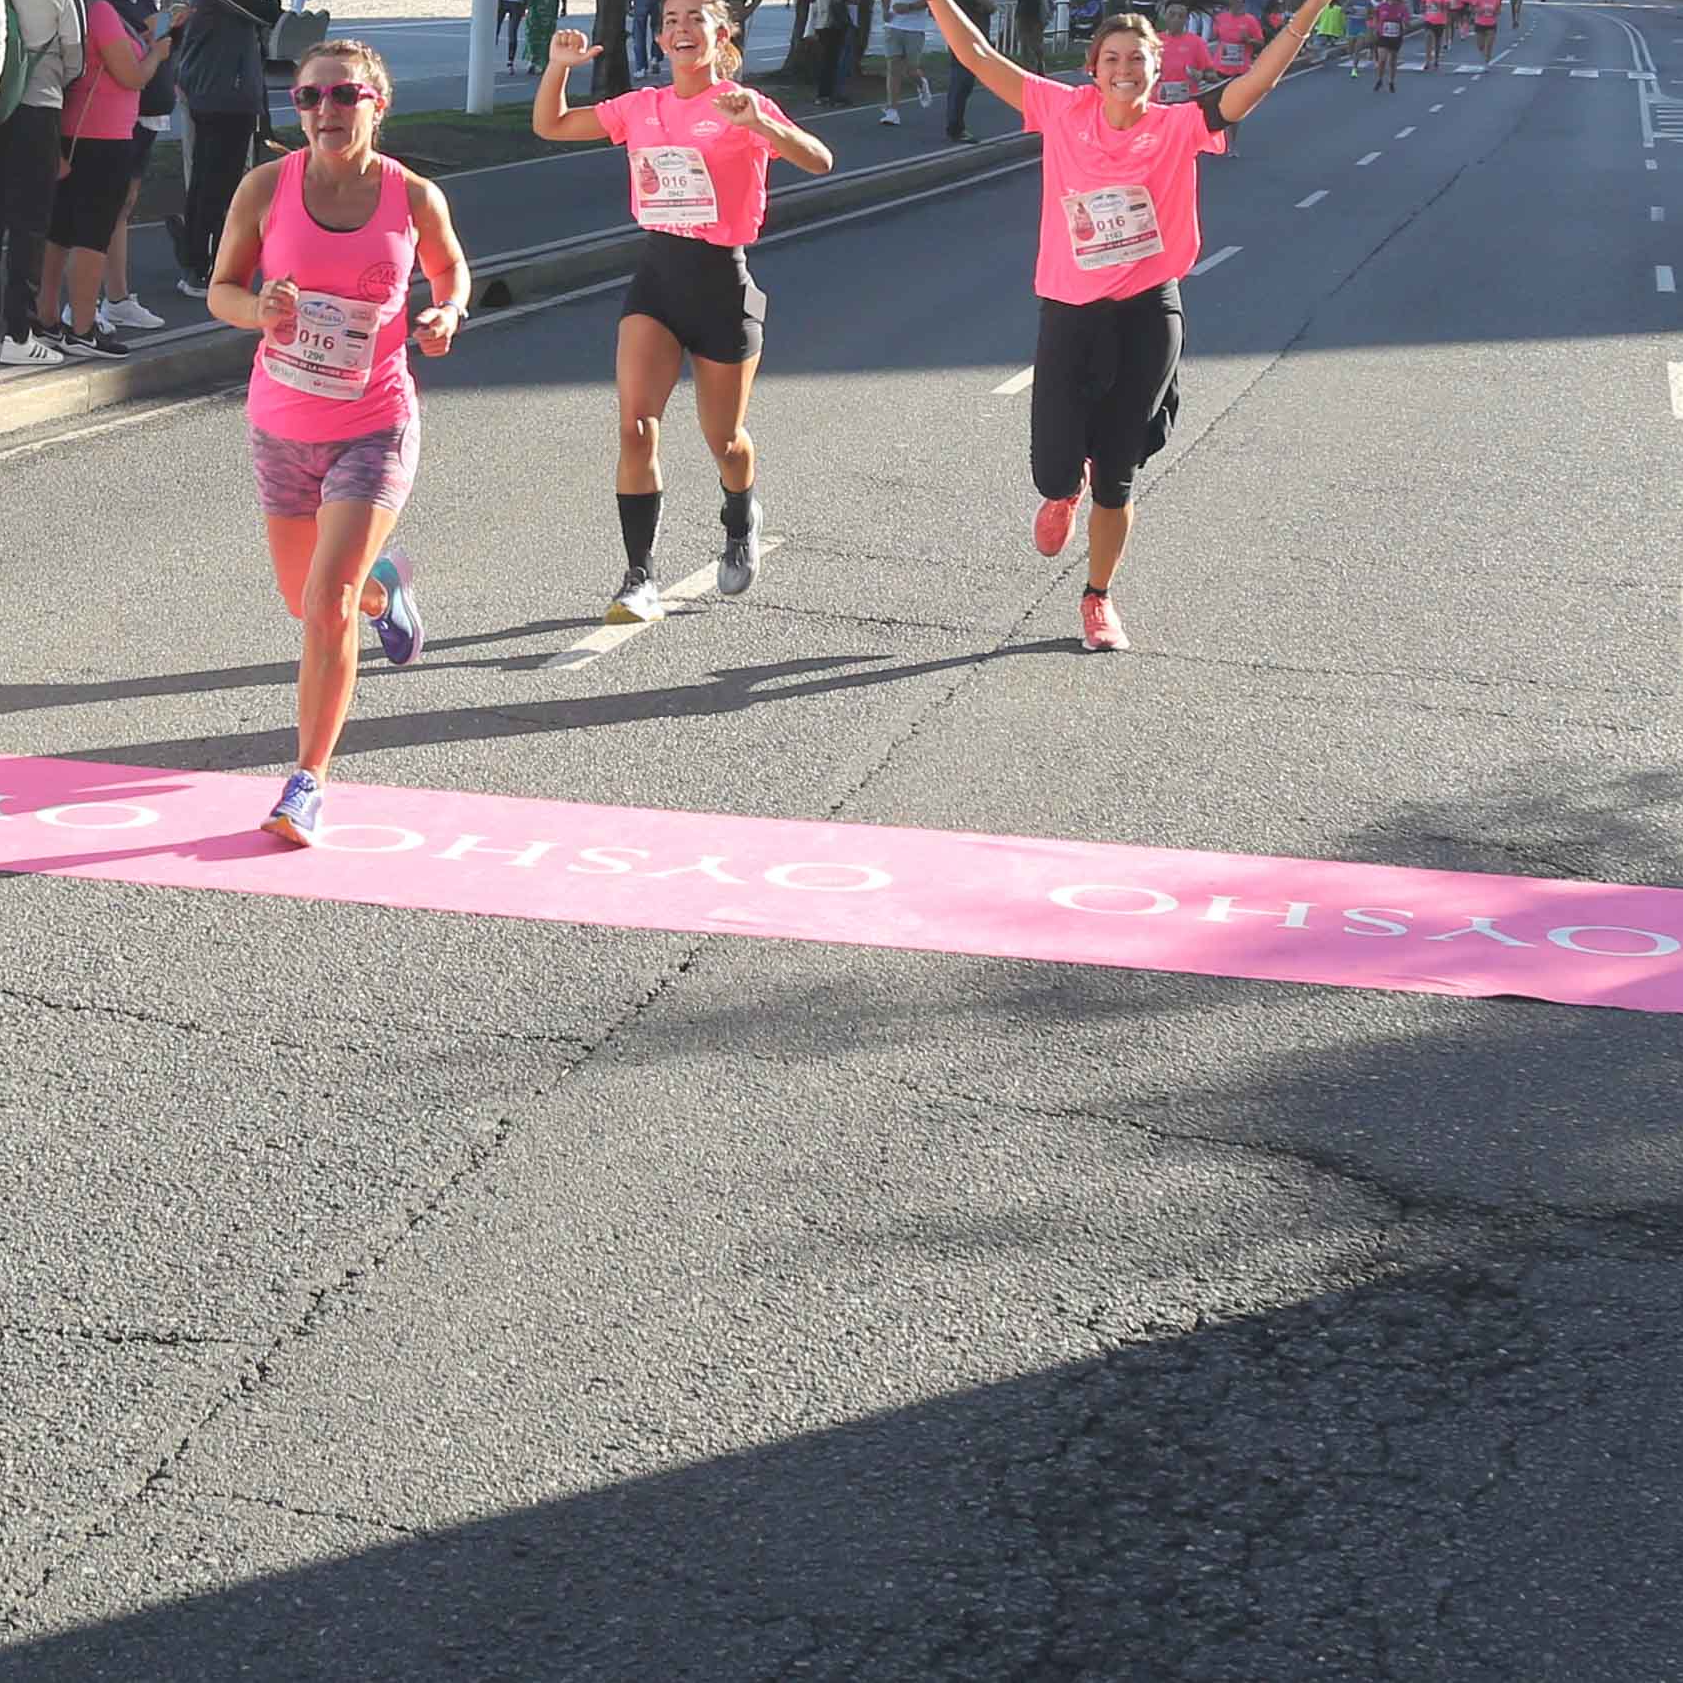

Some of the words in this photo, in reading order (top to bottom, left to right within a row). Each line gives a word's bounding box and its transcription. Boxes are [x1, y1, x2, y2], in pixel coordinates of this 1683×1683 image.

[1097, 215, 1125, 231] 016
[299, 329, 335, 349] 016
[315, 823, 894, 892] OYSHO
[1048, 884, 1682, 957] OYSHO
